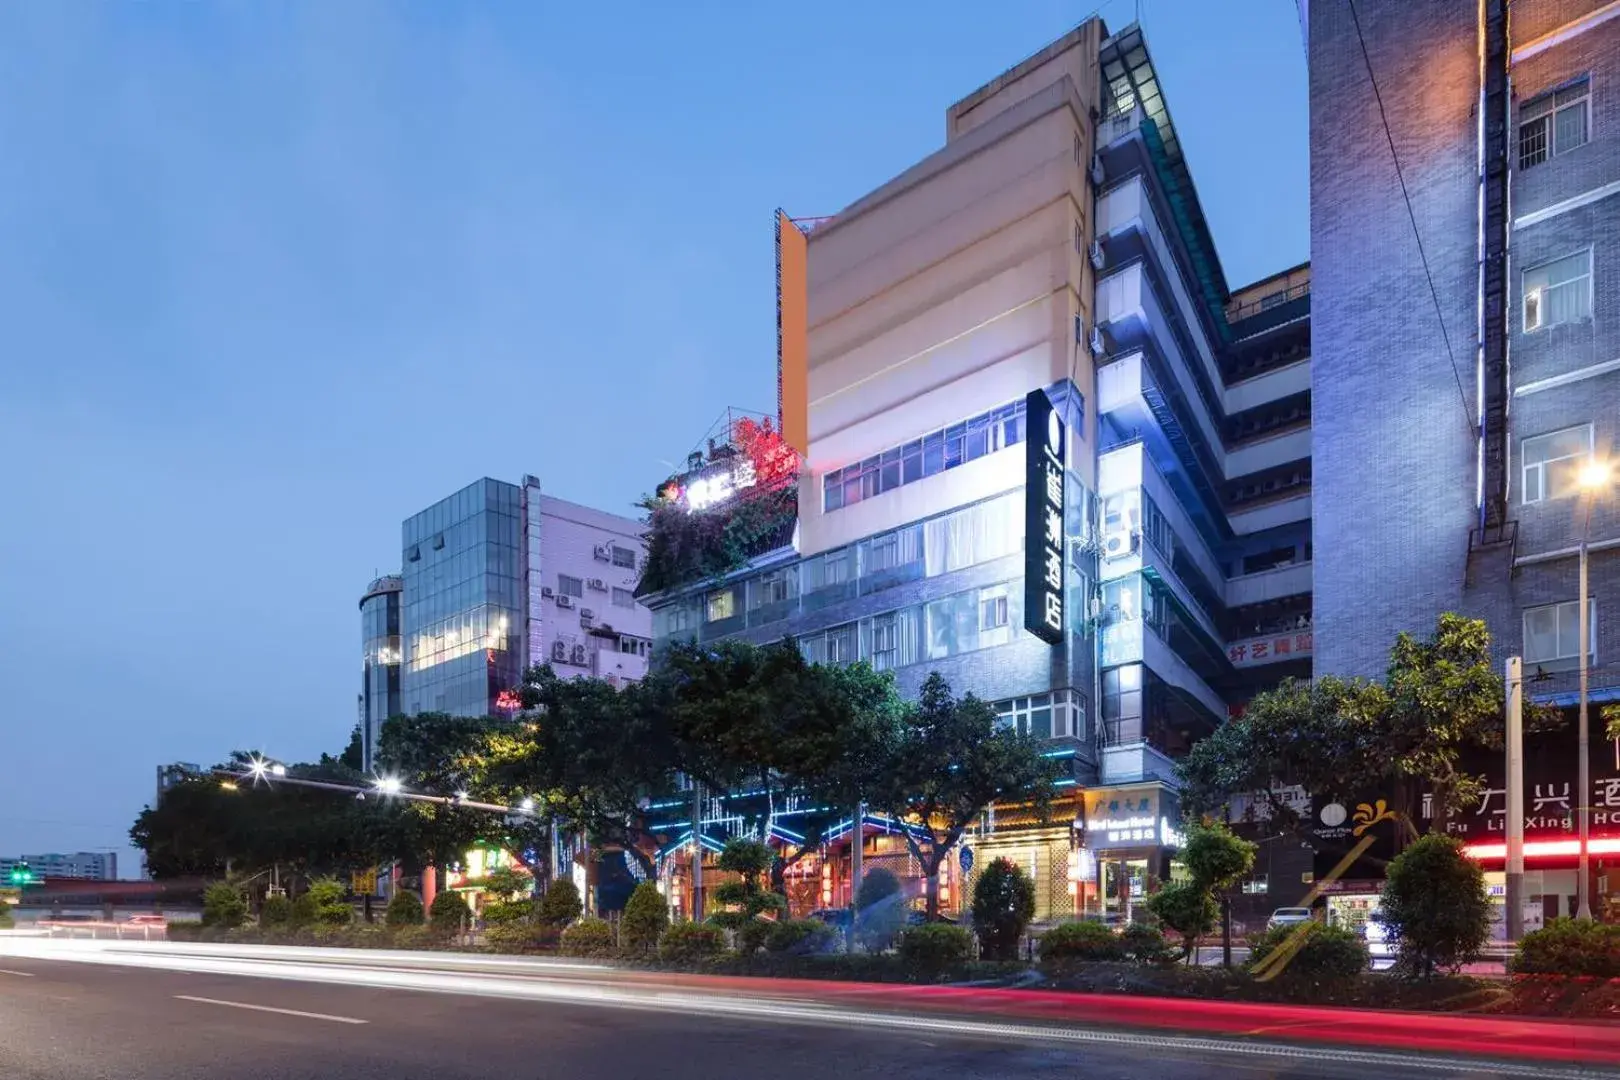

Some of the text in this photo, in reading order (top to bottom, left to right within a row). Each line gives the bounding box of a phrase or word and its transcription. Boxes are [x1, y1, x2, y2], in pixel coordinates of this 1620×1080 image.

[1446, 822, 1468, 832] Fu
[1487, 819, 1504, 831] Li
[1525, 813, 1573, 831] Xing
